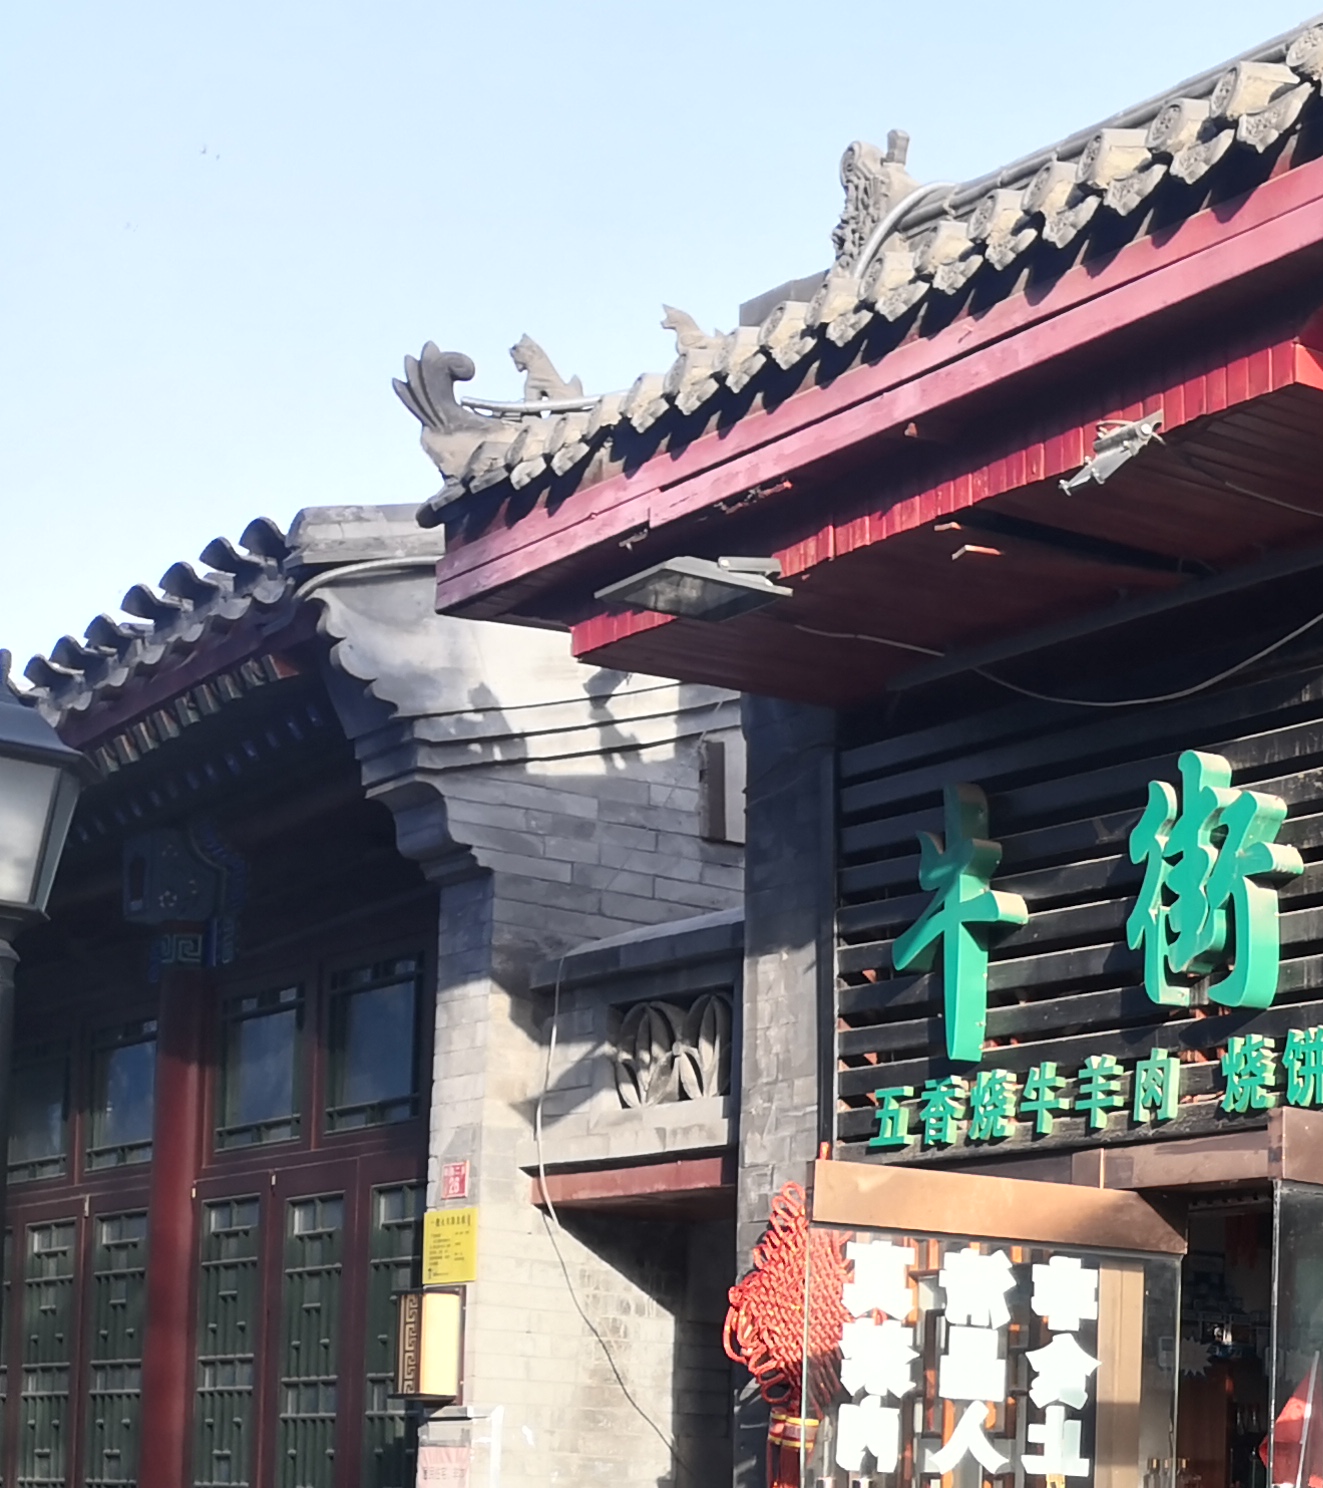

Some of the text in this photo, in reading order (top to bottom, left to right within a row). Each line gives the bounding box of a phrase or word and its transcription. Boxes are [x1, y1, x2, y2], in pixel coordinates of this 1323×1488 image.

[868, 1047, 1181, 1147] 五香烧牛羊肉
